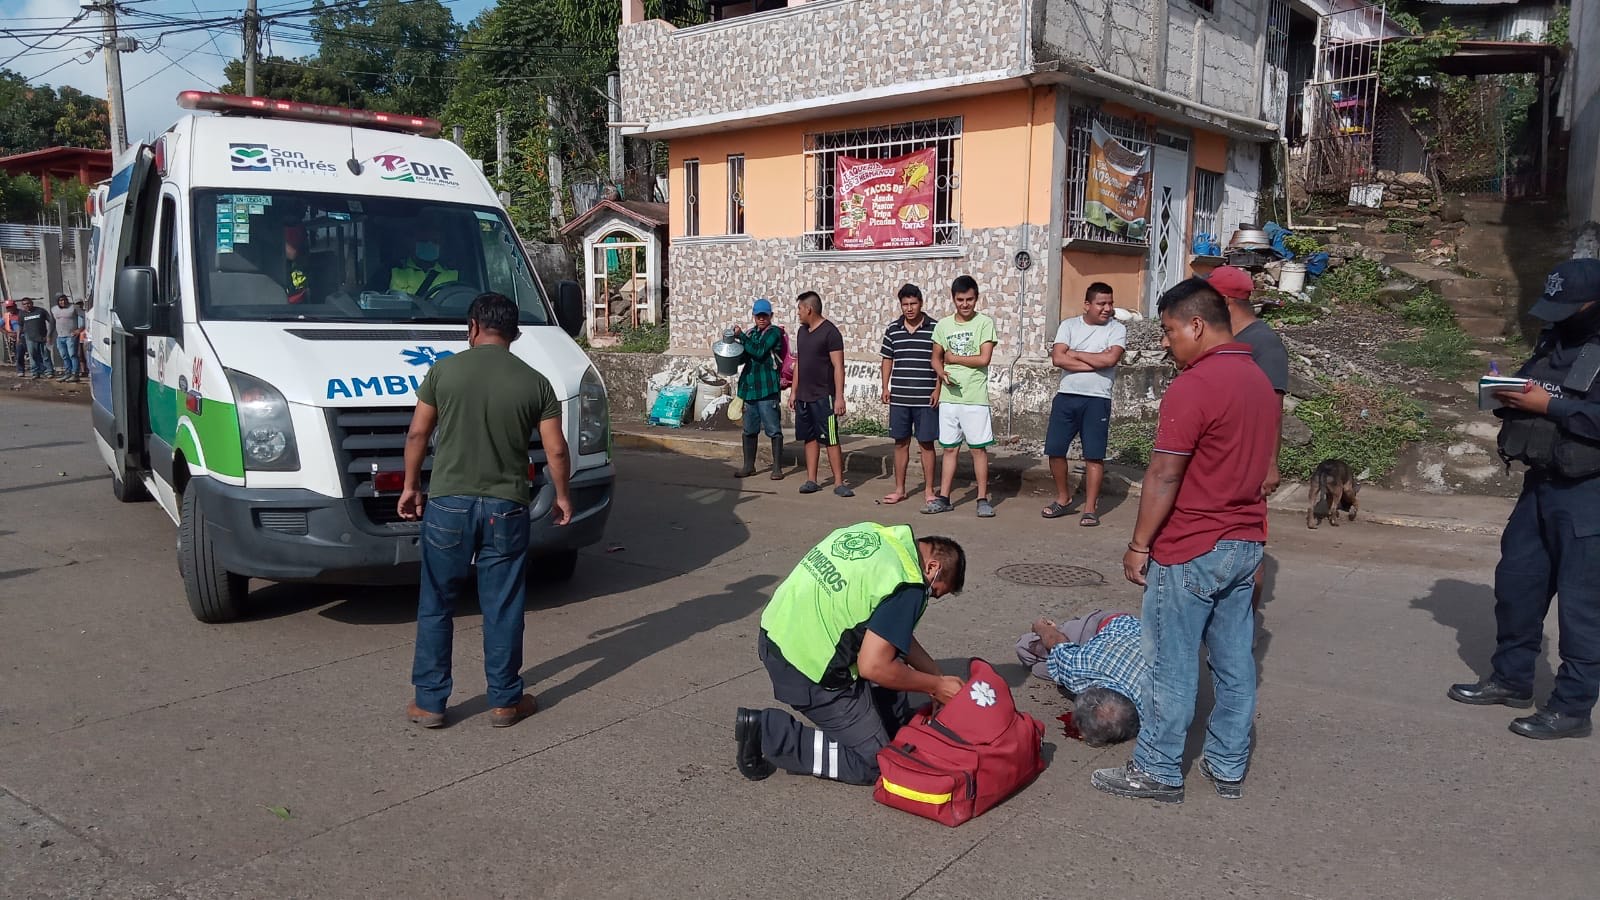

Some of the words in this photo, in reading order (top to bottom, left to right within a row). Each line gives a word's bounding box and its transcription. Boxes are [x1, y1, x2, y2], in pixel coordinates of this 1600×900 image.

[270, 148, 304, 159] San
[272, 158, 337, 172] Andrés
[410, 162, 454, 180] DIF
[864, 184, 892, 196] TACOS
[892, 184, 904, 193] DE
[871, 202, 895, 210] Pastor
[873, 210, 892, 218] Tripa
[901, 222, 925, 230] TORTAS
[806, 547, 848, 593] OMBEROS
